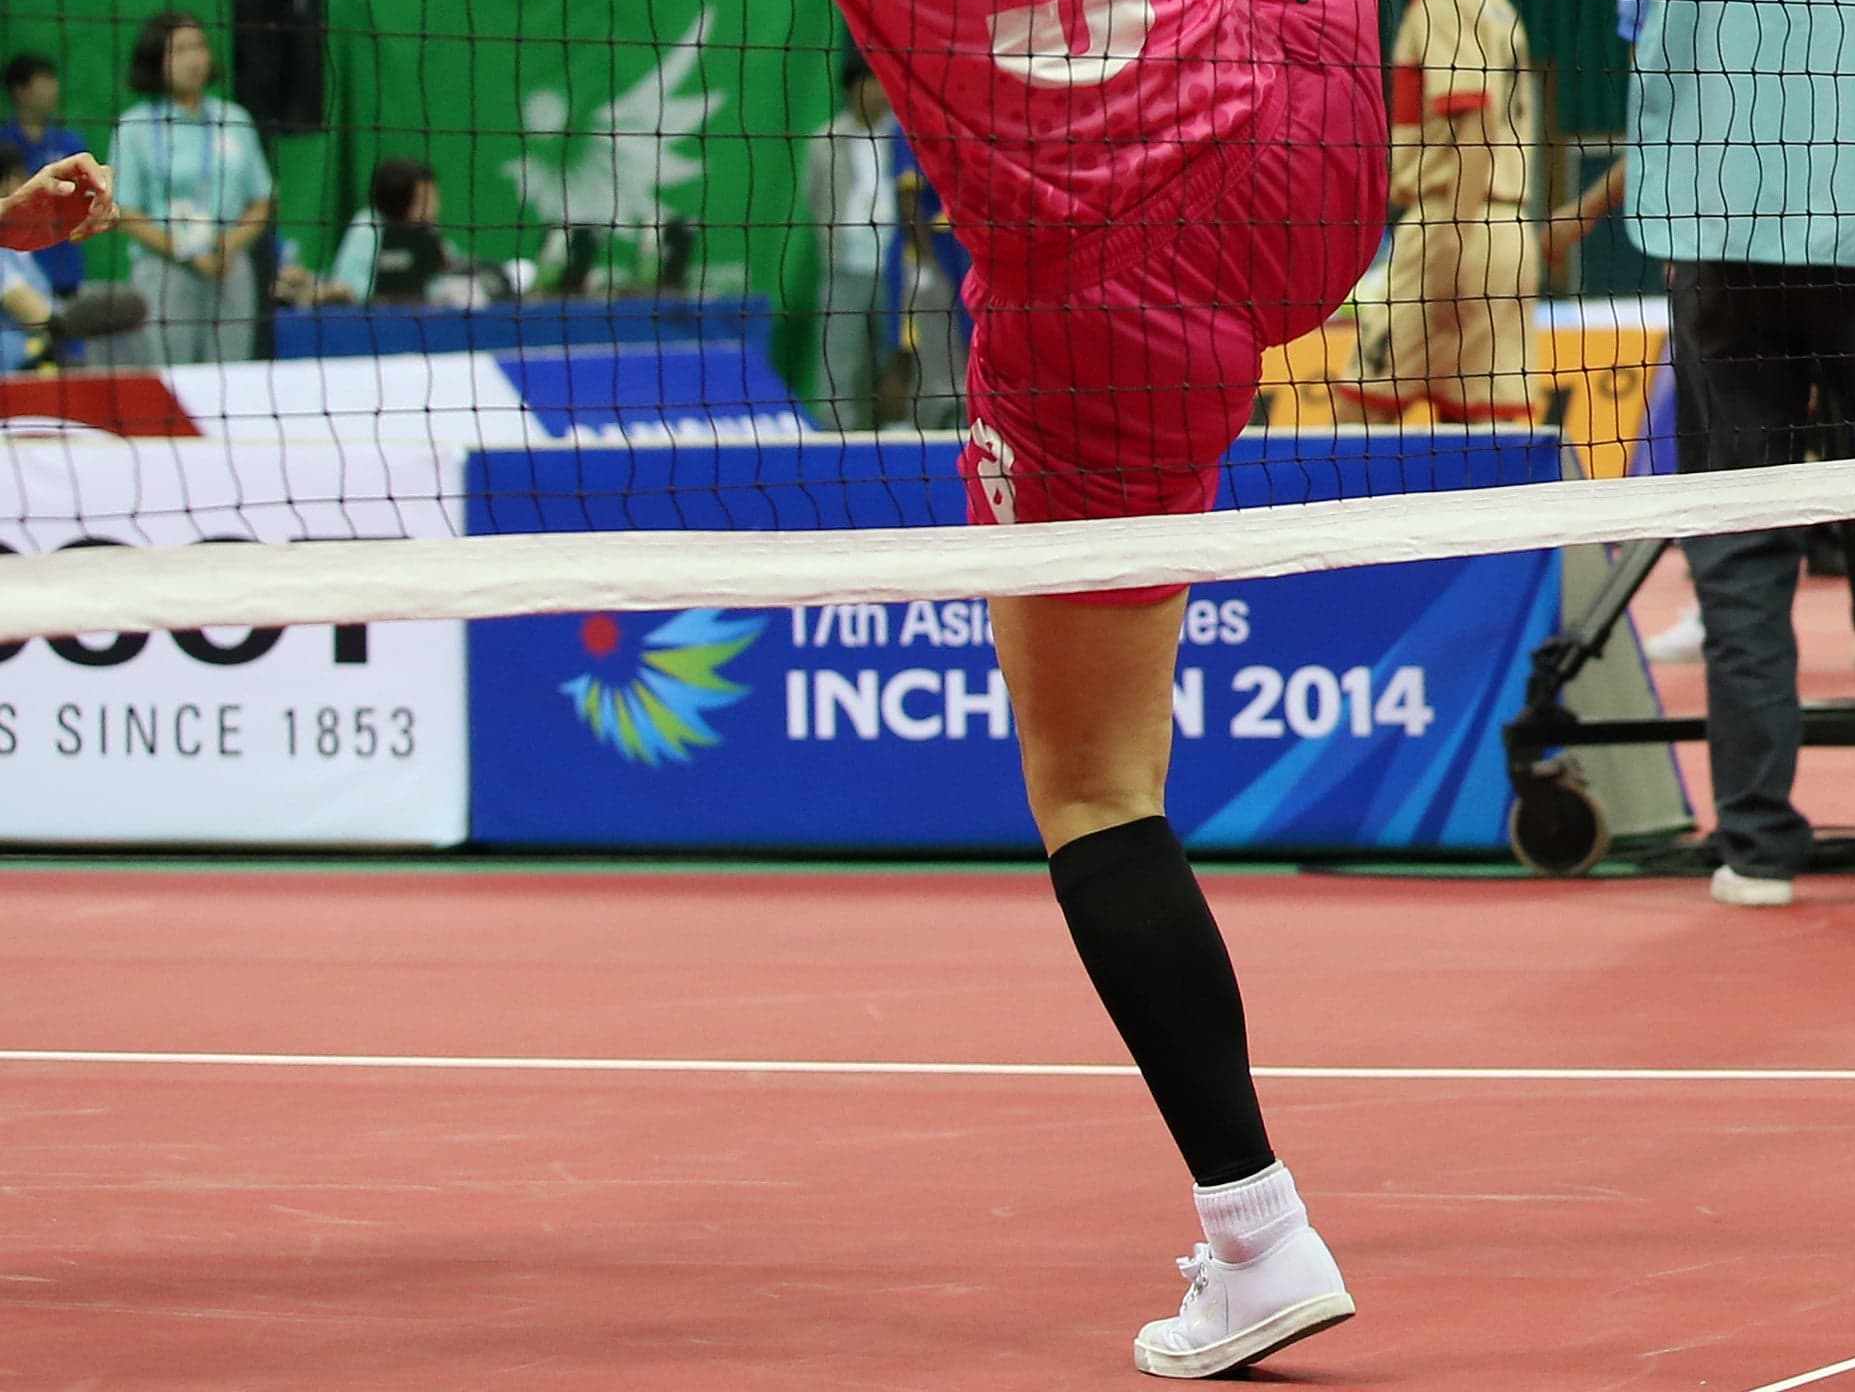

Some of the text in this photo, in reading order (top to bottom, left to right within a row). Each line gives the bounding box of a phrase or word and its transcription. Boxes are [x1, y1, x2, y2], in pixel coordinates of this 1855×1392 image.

[55, 701, 244, 758] SINCE
[284, 705, 416, 759] 1853
[785, 665, 1435, 740] INCHN 2014
